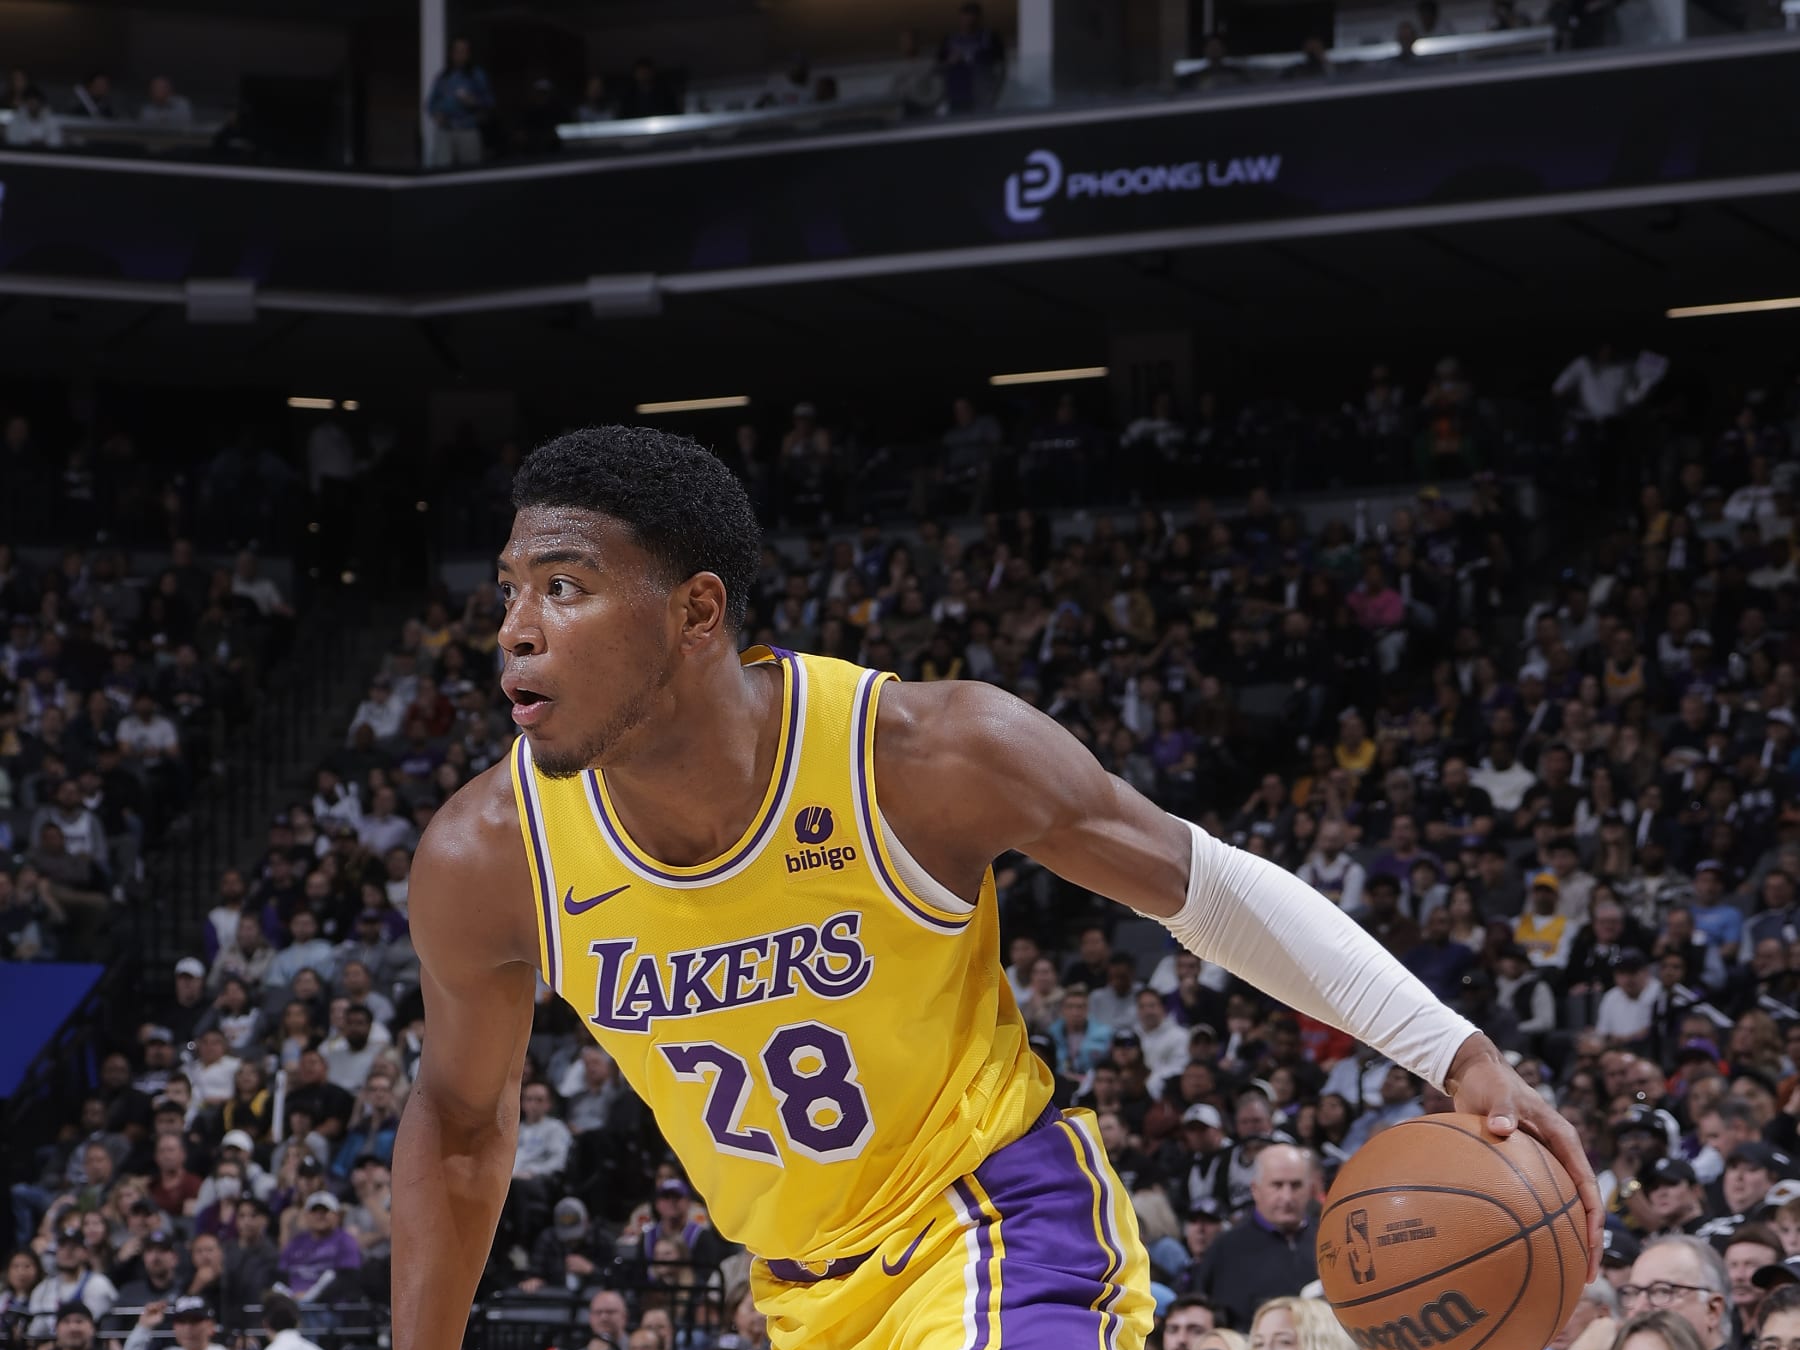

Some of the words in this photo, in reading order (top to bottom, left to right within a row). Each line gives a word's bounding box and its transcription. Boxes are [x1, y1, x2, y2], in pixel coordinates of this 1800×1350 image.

[1067, 161, 1202, 198] PHOONG
[1207, 154, 1281, 187] LAW
[784, 845, 857, 874] bibigo
[588, 911, 875, 1034] LAKERS
[656, 1019, 876, 1169] 28
